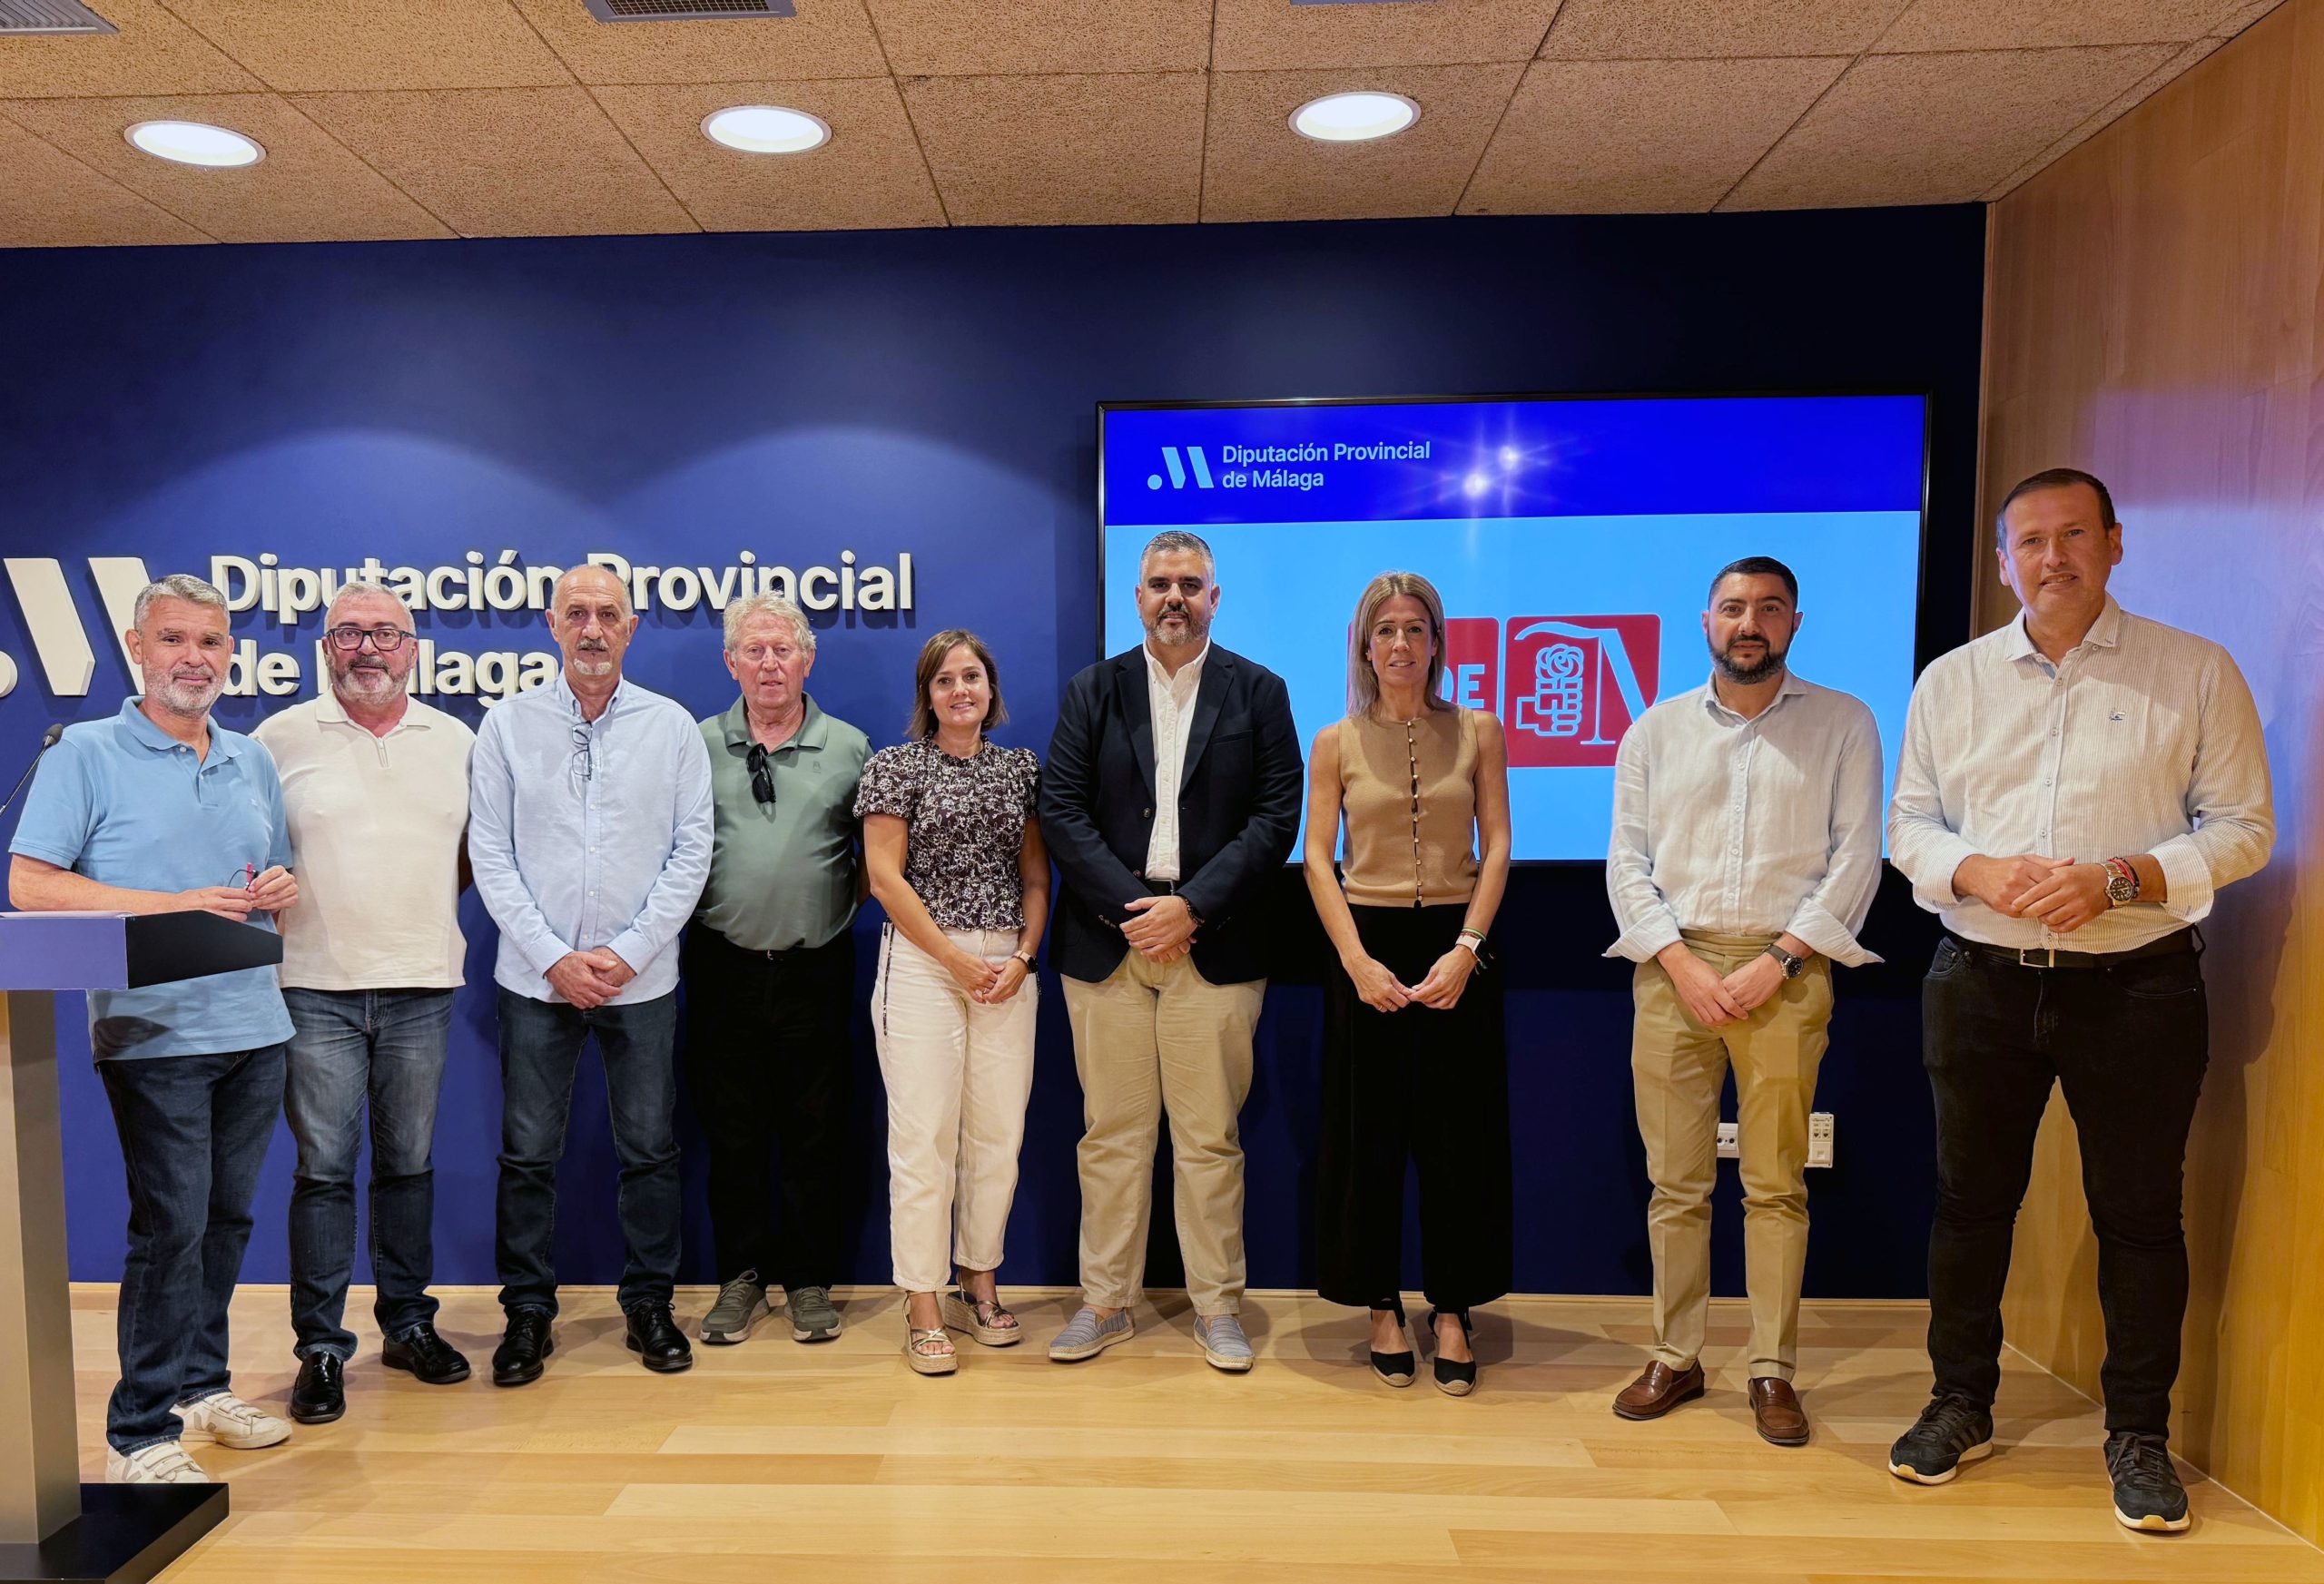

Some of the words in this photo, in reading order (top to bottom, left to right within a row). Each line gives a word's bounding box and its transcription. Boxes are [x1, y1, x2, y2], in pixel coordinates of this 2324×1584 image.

[1222, 444, 1328, 467] Diputación
[1334, 441, 1431, 461] Provincial
[1222, 470, 1247, 488] de
[1253, 469, 1324, 491] Málaga
[222, 639, 300, 696] de
[315, 638, 559, 708] laga
